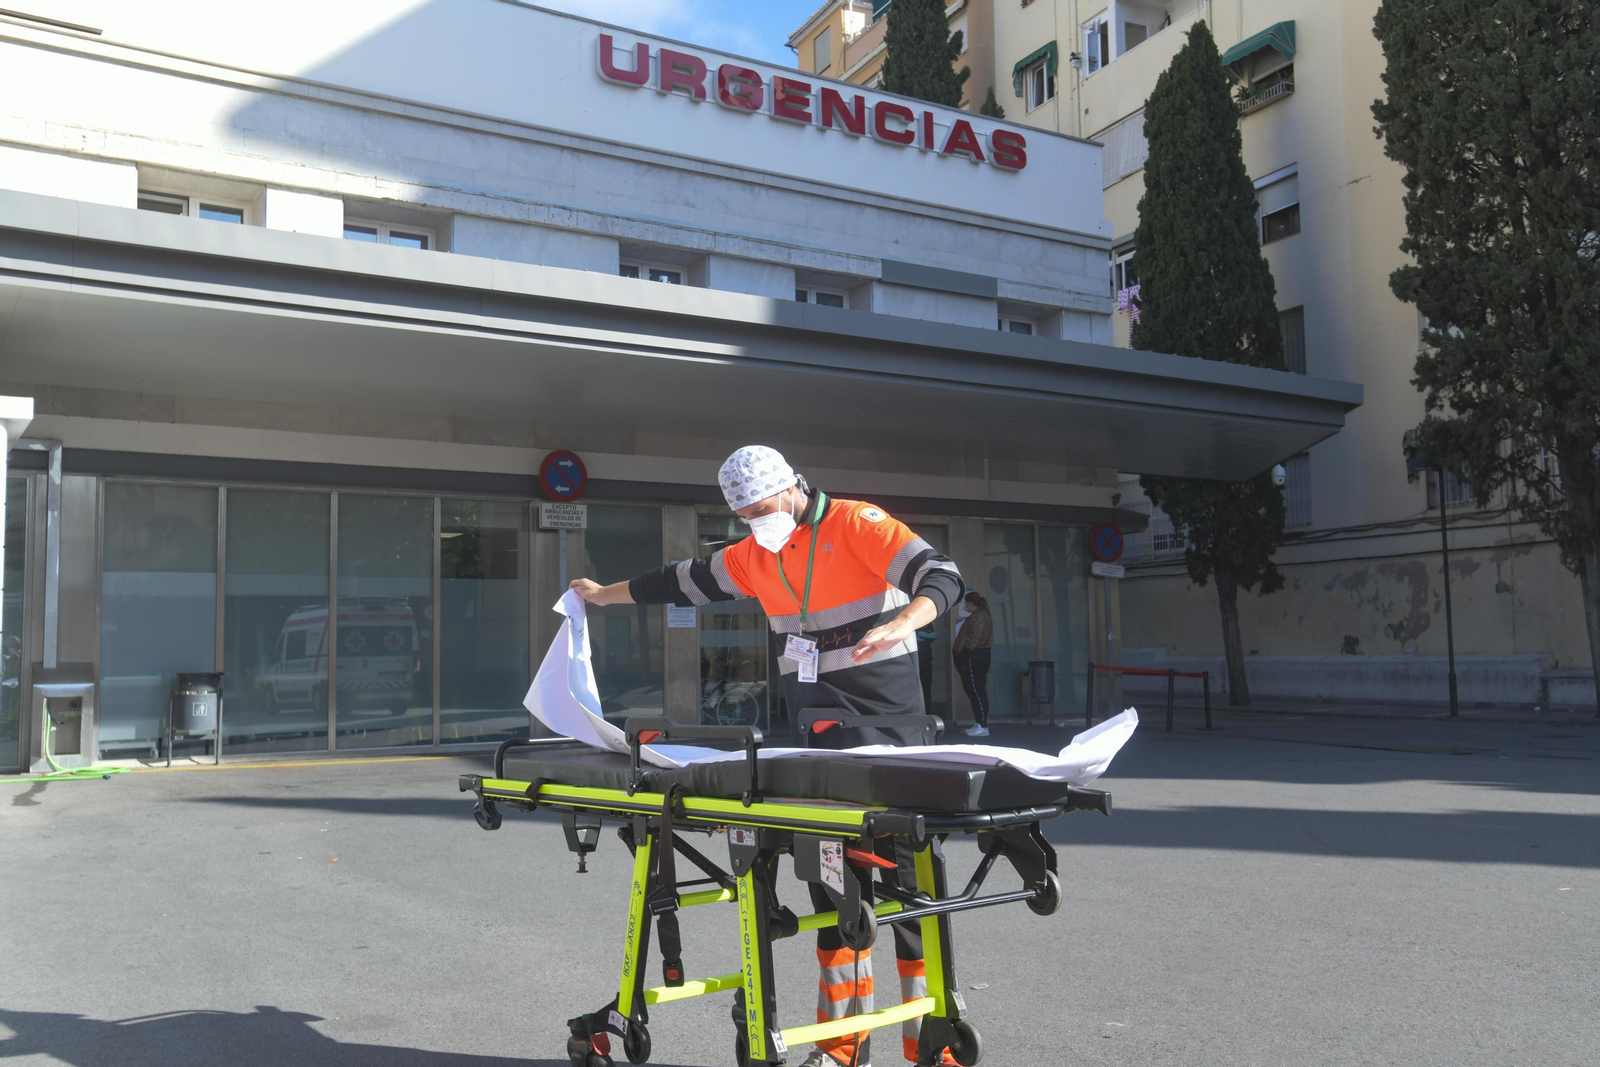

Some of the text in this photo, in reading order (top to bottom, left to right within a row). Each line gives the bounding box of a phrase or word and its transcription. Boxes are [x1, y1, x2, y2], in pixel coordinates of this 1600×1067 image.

[596, 33, 1027, 171] URGENCIAS
[743, 918, 757, 1022] TGE 241 M
